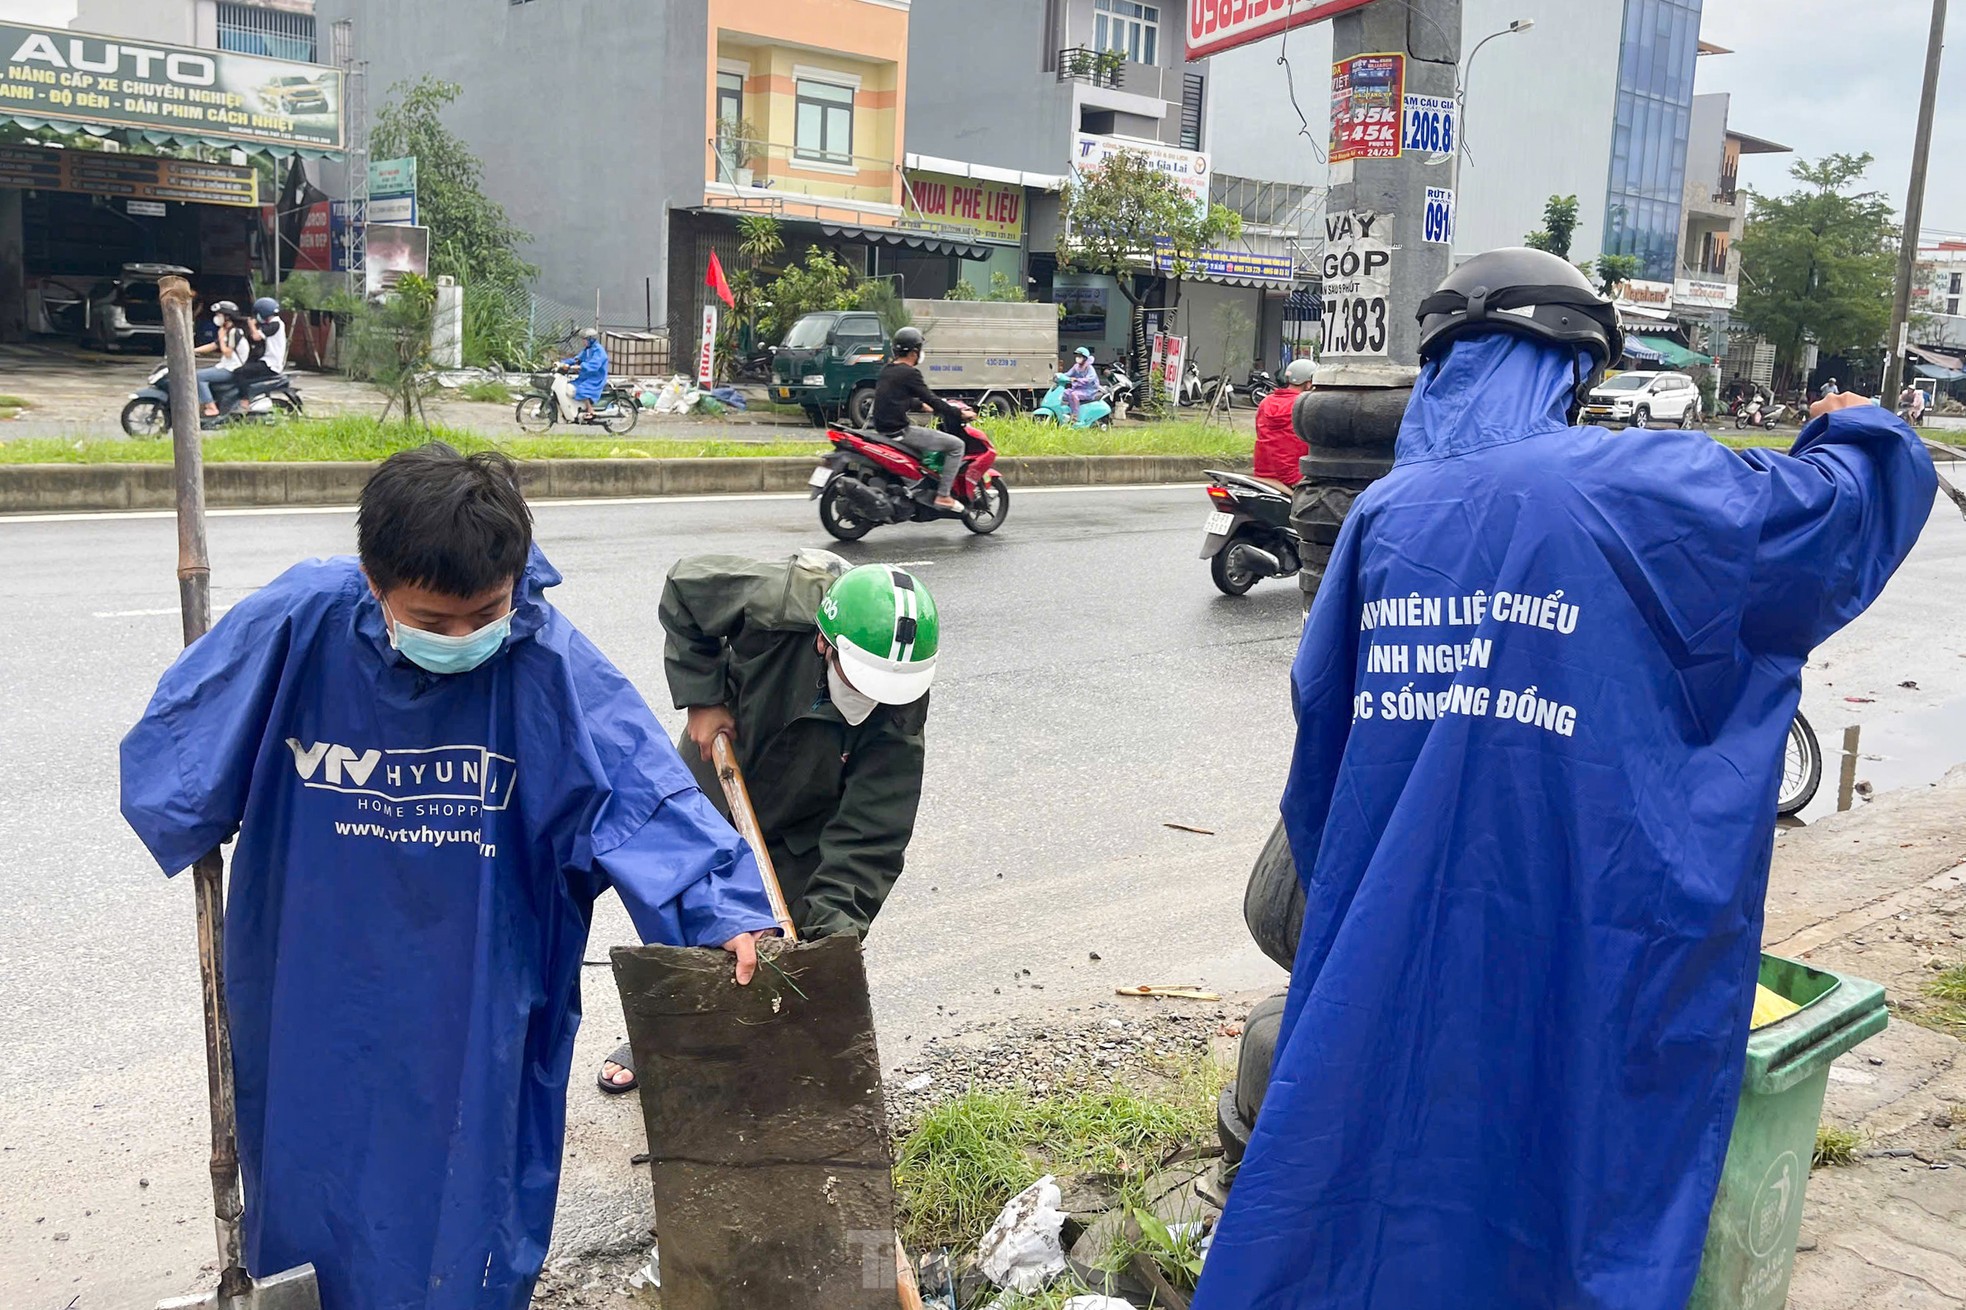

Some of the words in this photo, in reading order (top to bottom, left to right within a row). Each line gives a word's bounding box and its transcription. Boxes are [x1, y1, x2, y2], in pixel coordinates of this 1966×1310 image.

[10, 33, 216, 86] AUTO
[8, 65, 56, 84] NÂNG
[60, 70, 93, 88] CẤP
[98, 77, 119, 92] XE
[122, 80, 185, 100] CHUYÊN
[188, 88, 243, 108] NGHIỆP
[50, 89, 73, 106] ĐỘ
[76, 92, 110, 109] ĐÈN
[125, 98, 158, 115] DÁN
[162, 103, 204, 120] PHIM
[207, 108, 248, 126] CÁCH
[252, 114, 295, 132] NHIỆT
[1353, 107, 1397, 123] 35k
[1351, 125, 1395, 141] 45k
[1156, 158, 1172, 172] Gia
[1173, 163, 1188, 174] Lai
[1367, 148, 1394, 157] 24/24
[910, 180, 946, 215] MUA
[951, 179, 985, 219] PHẾ
[986, 186, 1020, 230] LIỆU
[1325, 213, 1376, 242] VAY
[1323, 245, 1389, 279] GÓP
[1492, 590, 1580, 635] CHIỂU
[1496, 684, 1578, 738] ĐỒNG
[285, 737, 382, 787] VTV
[387, 761, 480, 787] HYUN
[358, 798, 404, 818] HOME
